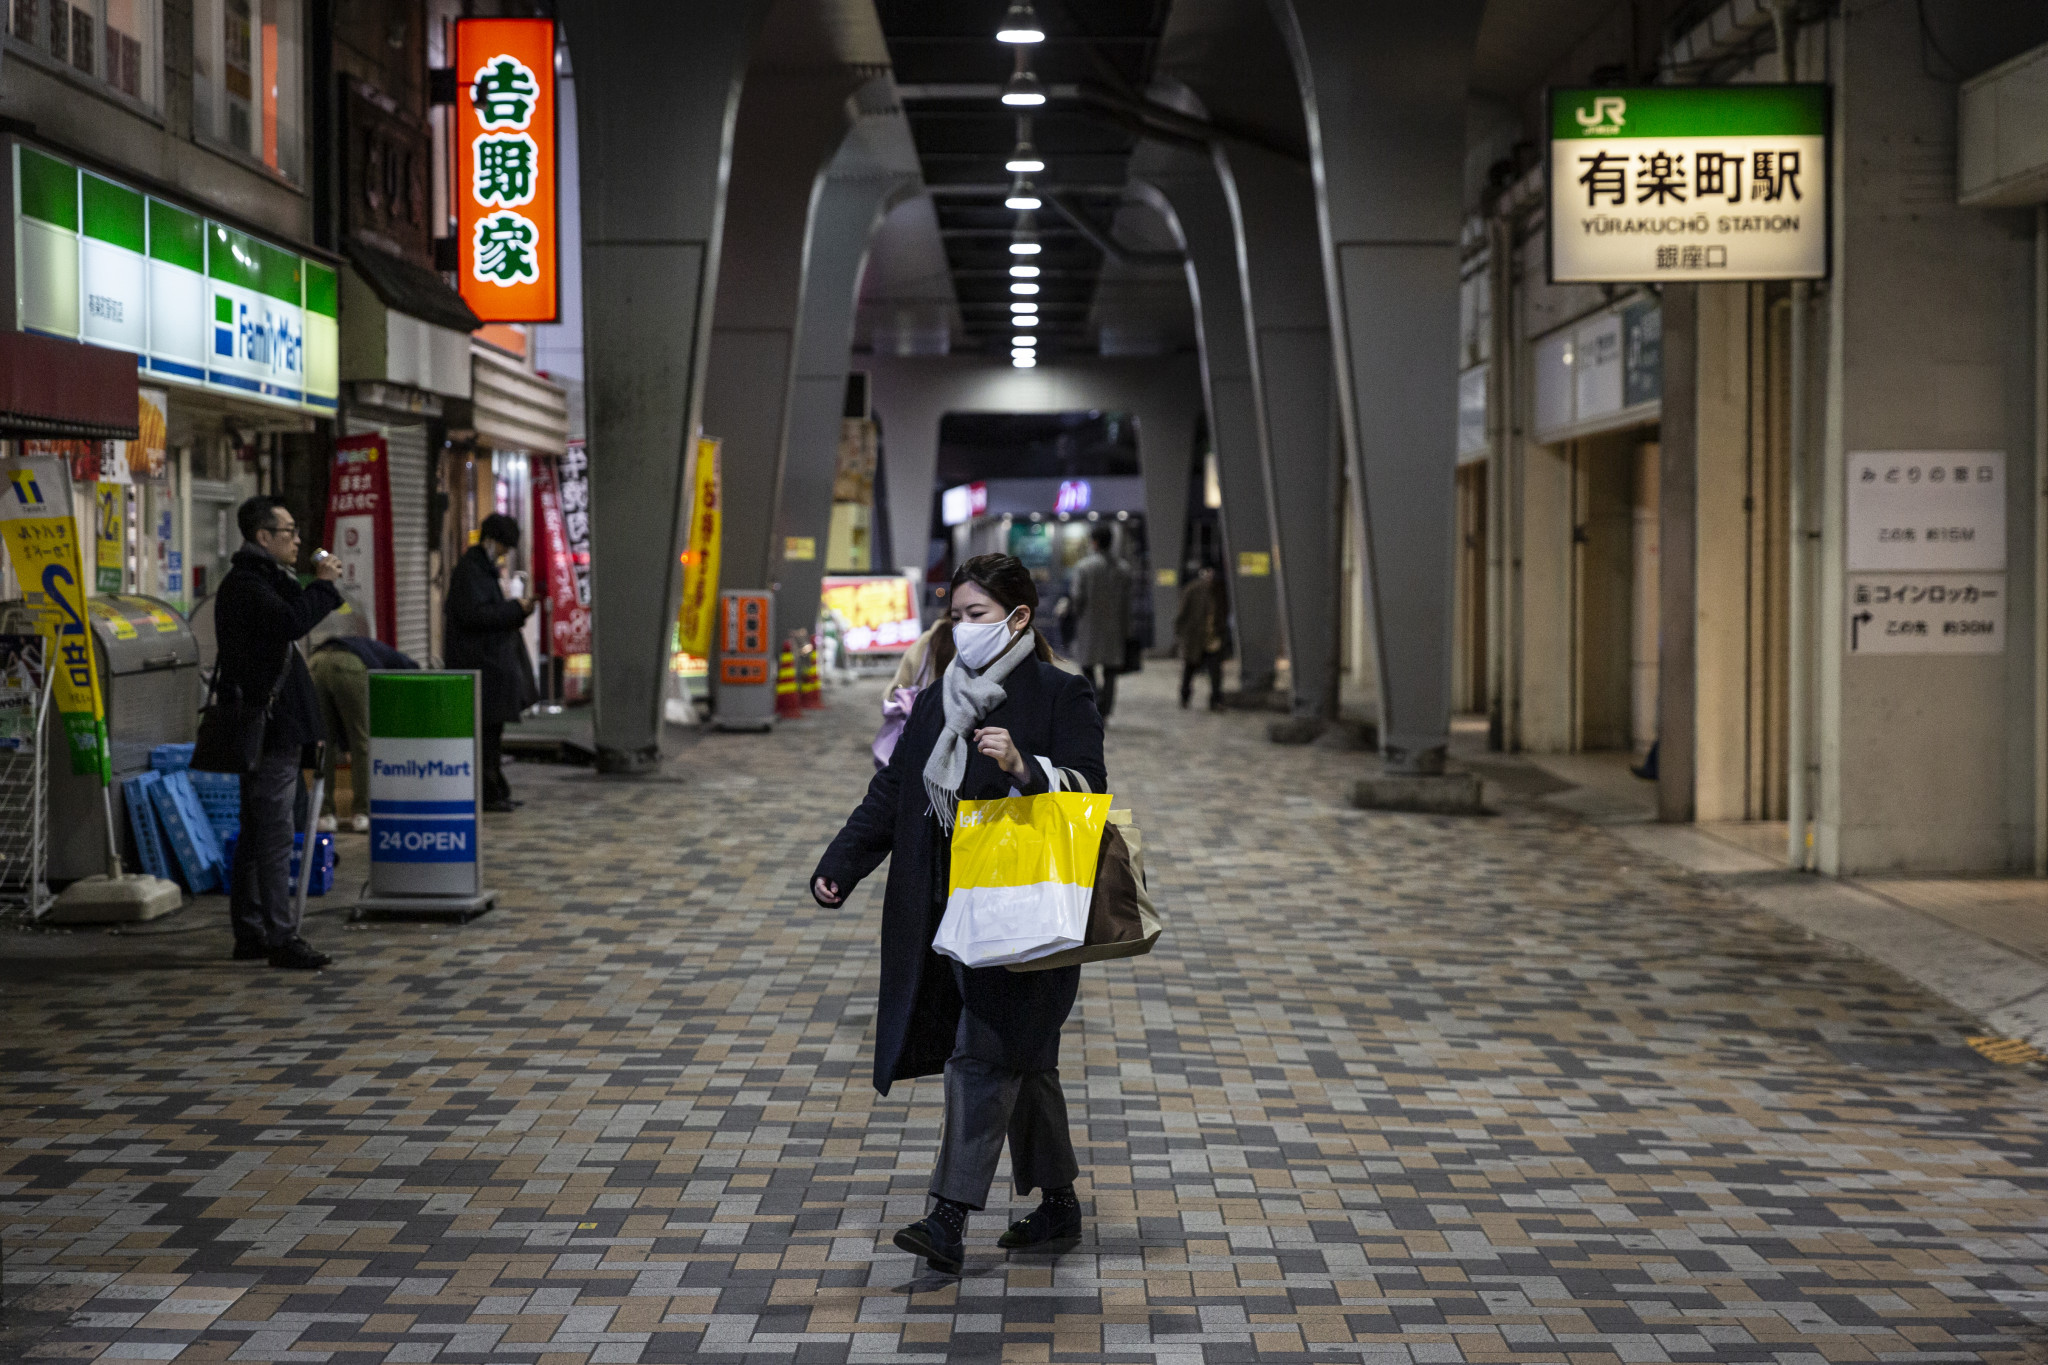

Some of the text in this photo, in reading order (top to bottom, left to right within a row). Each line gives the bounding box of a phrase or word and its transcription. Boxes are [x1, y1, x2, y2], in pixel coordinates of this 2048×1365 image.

[1576, 96, 1626, 126] JR
[472, 56, 538, 285] 吉野家
[1578, 151, 1802, 207] 有楽町駅
[1717, 215, 1801, 234] STATION
[1656, 245, 1727, 269] 銀座口
[240, 303, 303, 374] FamilyMart
[1874, 585, 1998, 604] コインロッカー
[373, 759, 470, 779] FamilyMart
[379, 831, 466, 851] 24 OPEN
